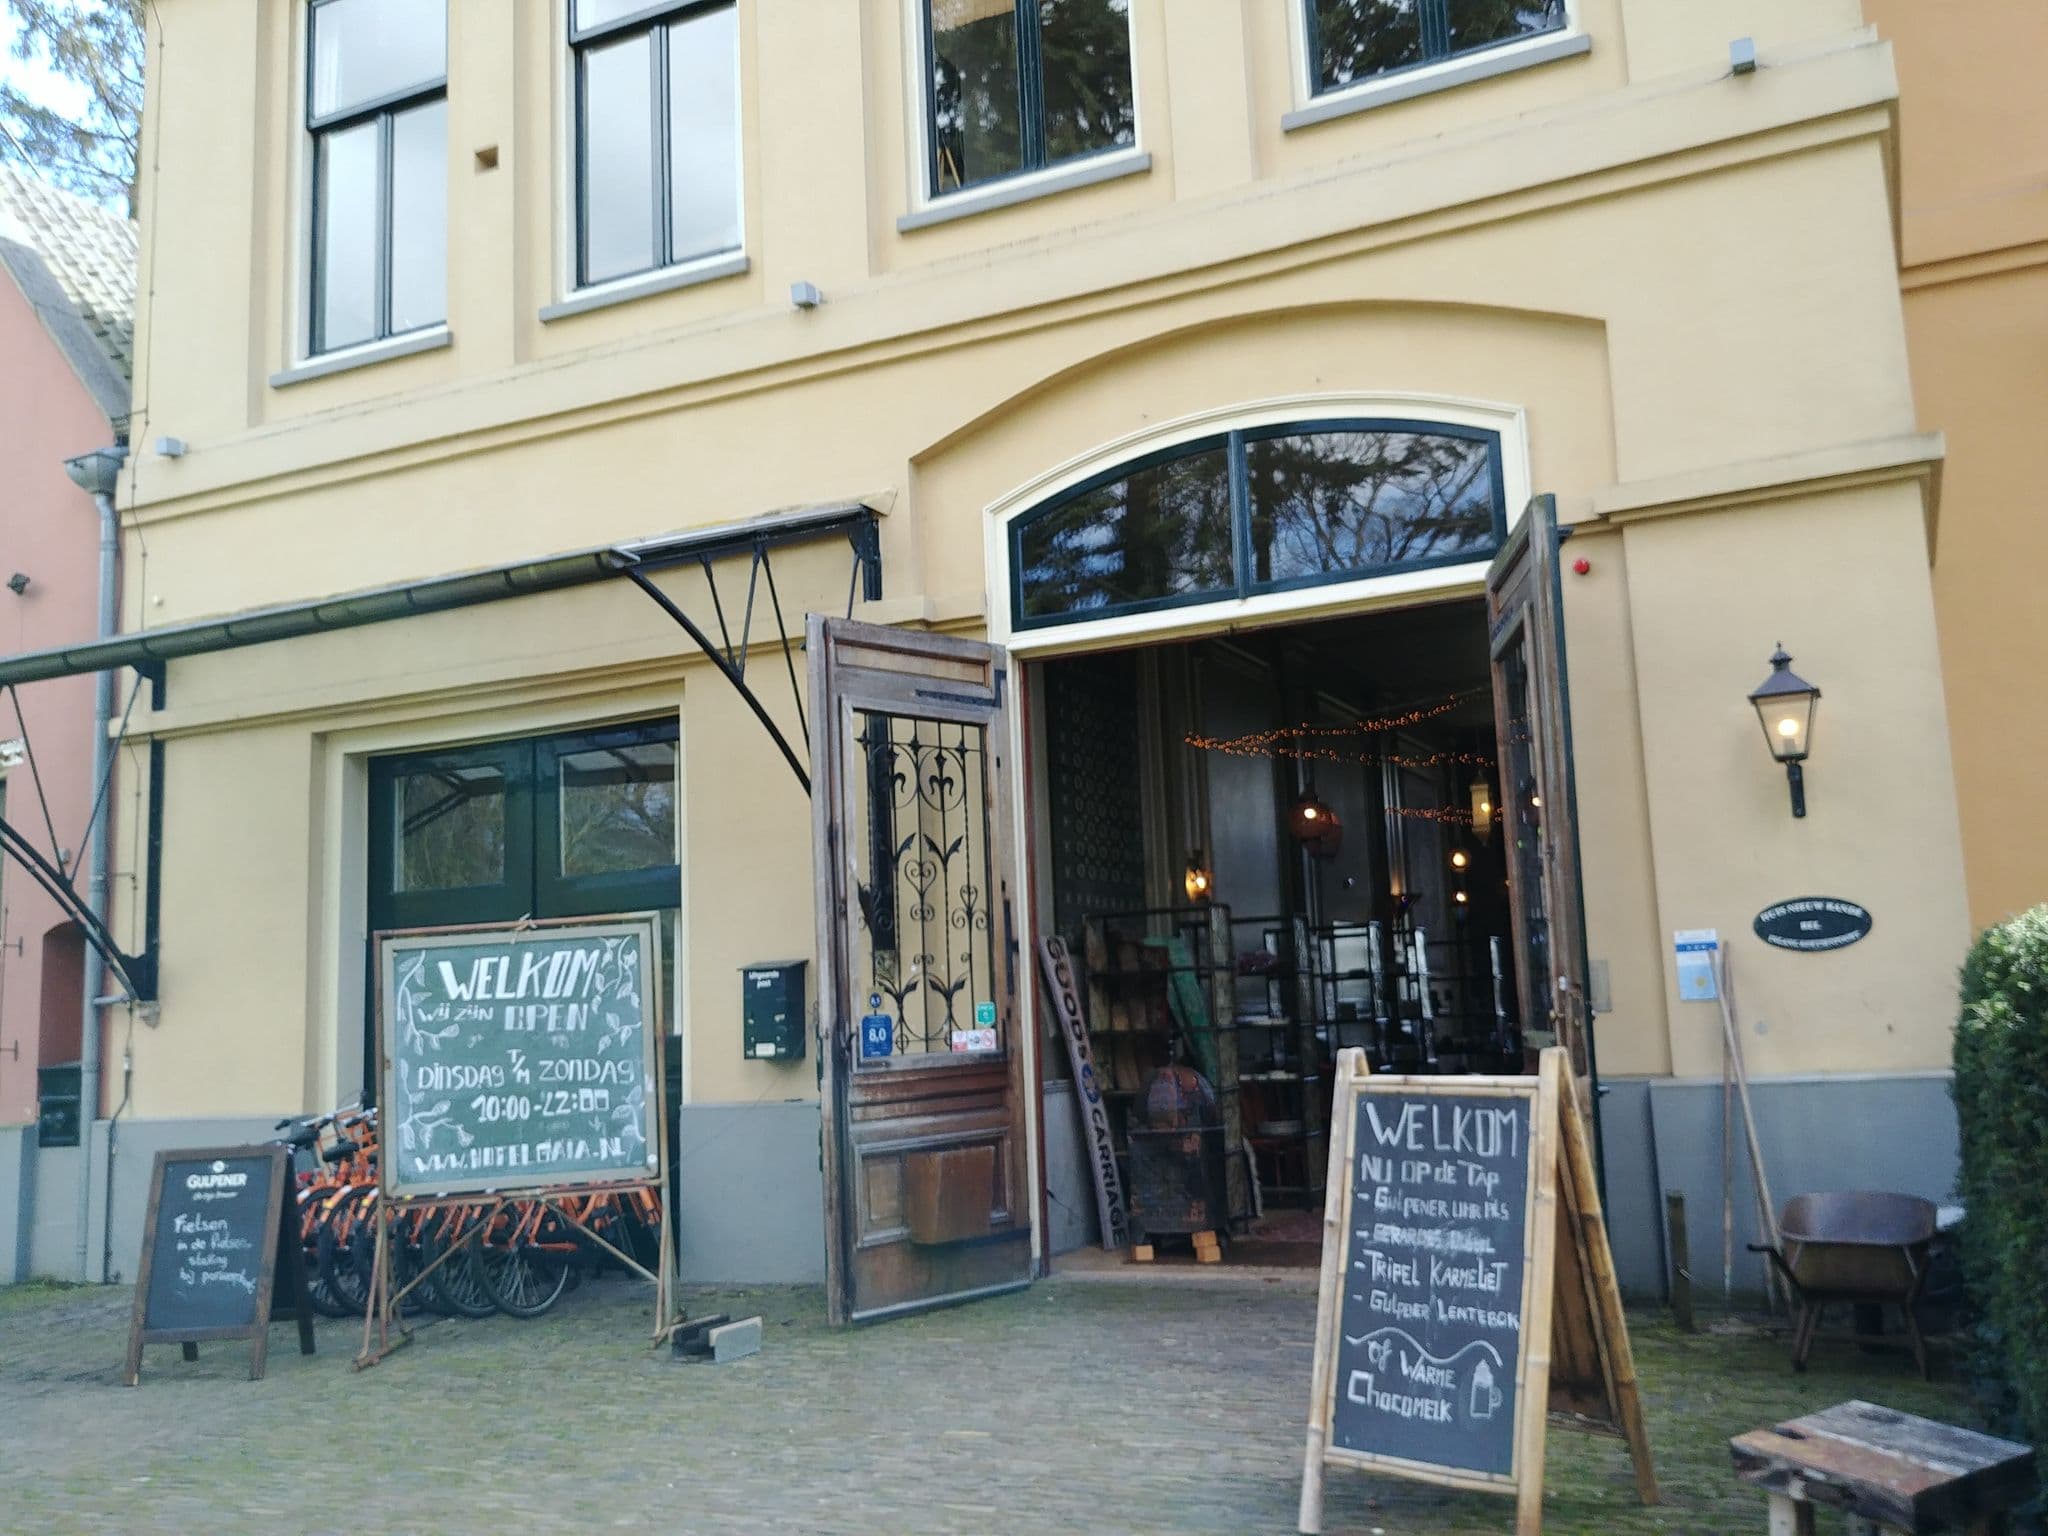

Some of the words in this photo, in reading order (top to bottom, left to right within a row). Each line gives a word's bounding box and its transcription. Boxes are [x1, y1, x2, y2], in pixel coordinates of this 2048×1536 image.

[438, 949, 600, 1001] WELKOM
[504, 1003, 589, 1031] OPEN
[1365, 1100, 1518, 1158] WELKOM
[186, 1173, 248, 1190] GULPENER
